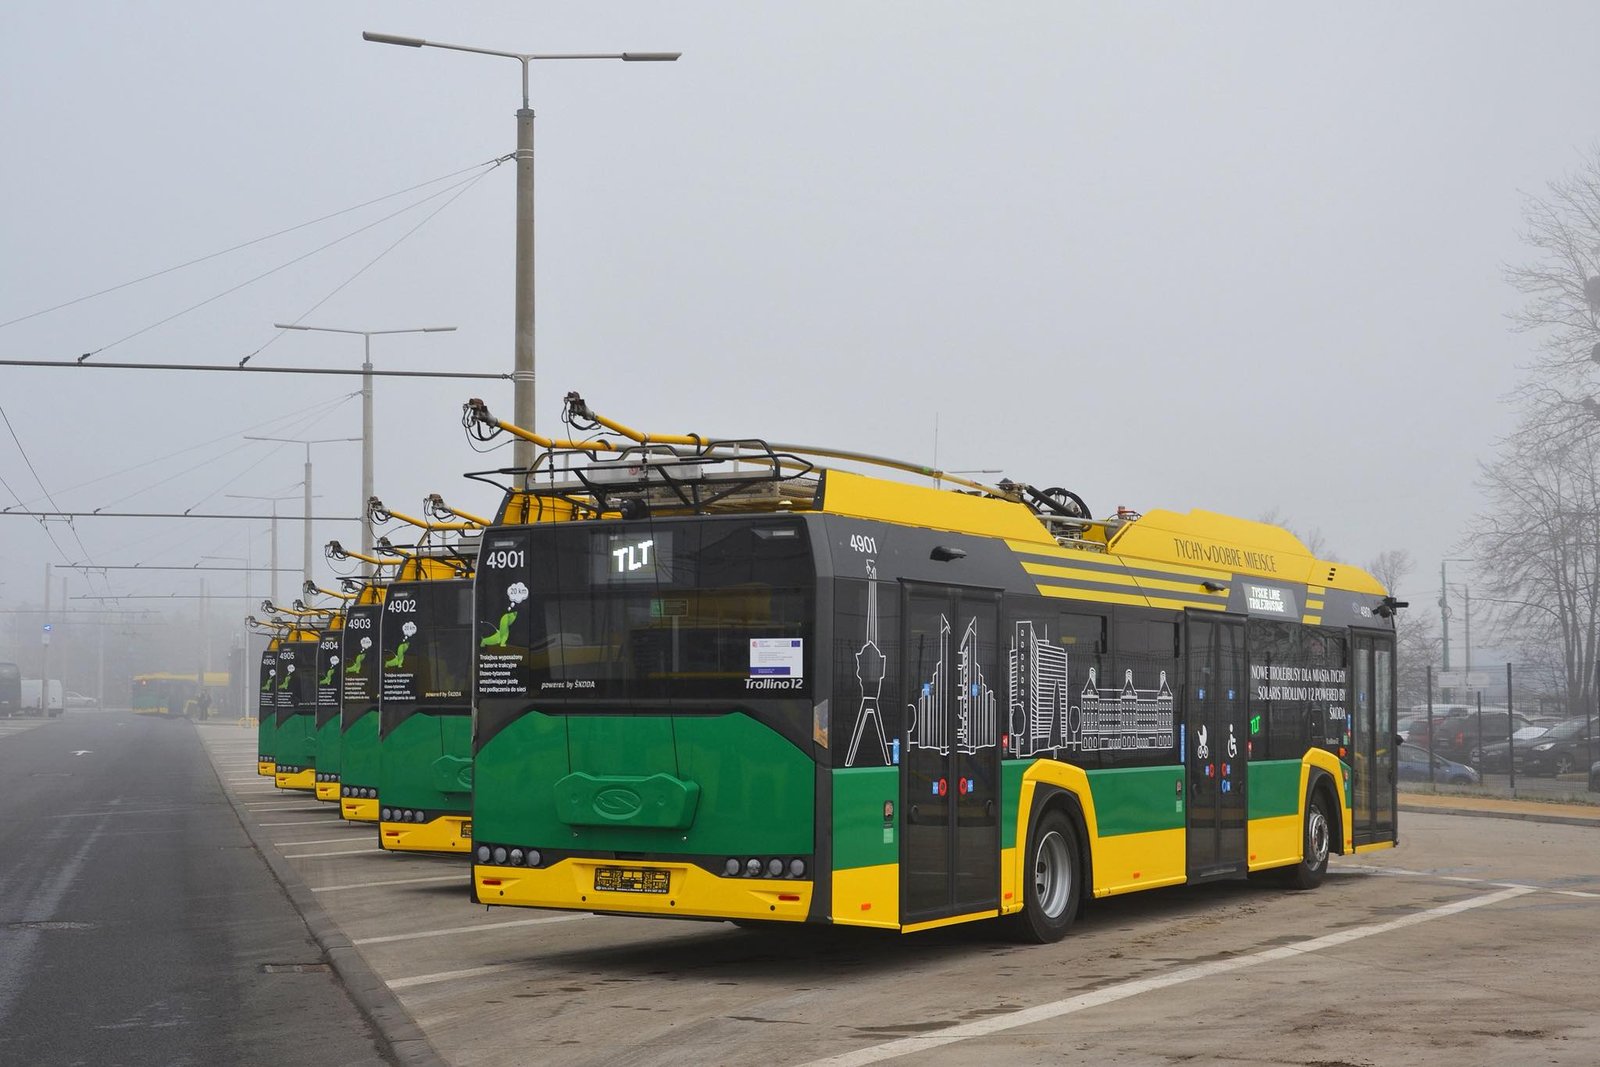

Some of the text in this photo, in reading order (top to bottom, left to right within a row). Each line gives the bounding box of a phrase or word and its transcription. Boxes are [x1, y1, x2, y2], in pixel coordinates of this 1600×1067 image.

[850, 534, 877, 554] 4901
[486, 550, 525, 569] 4901
[613, 540, 654, 573] TLT
[1174, 538, 1277, 573] TYCHY DOBRE MIEJSCE
[510, 587, 527, 595] 20 km
[388, 599, 417, 613] 4902
[348, 618, 371, 630] 4903
[320, 641, 339, 650] 4904
[1251, 665, 1346, 683] NOWE TROLEJBUSY DLA MIASTA TYCHY
[566, 682, 574, 690] by
[574, 680, 595, 688] ŠKODA
[1258, 686, 1346, 702] SOLARIS TROLLINO 12 POWERED BY
[1329, 704, 1346, 720] ŠKODA
